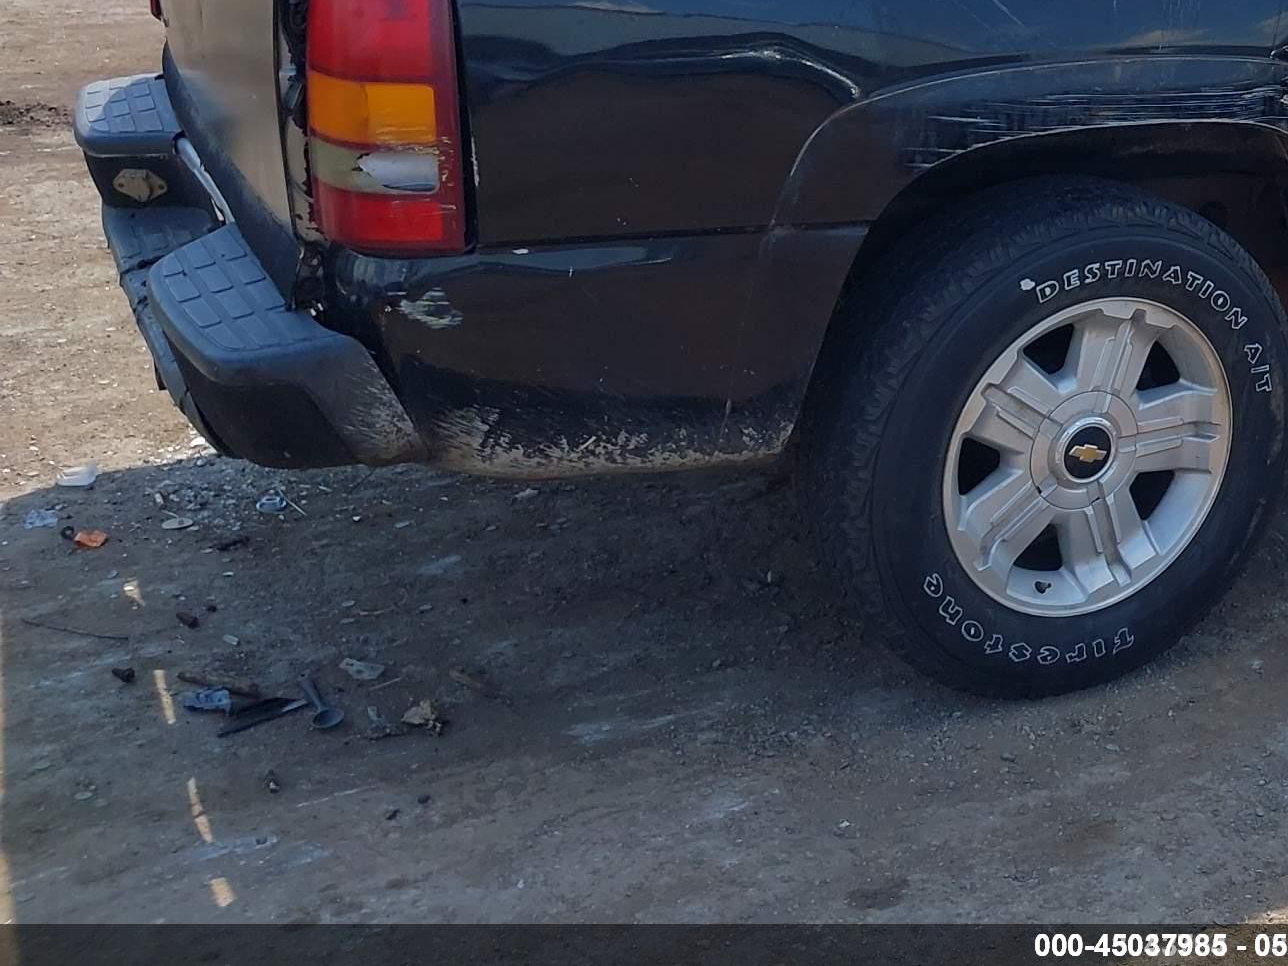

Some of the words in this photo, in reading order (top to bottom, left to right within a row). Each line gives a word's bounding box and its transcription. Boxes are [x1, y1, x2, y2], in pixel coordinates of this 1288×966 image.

[1036, 259, 1248, 330] DESTINATION
[1244, 343, 1273, 394] A/T
[923, 573, 1135, 665] Firestone
